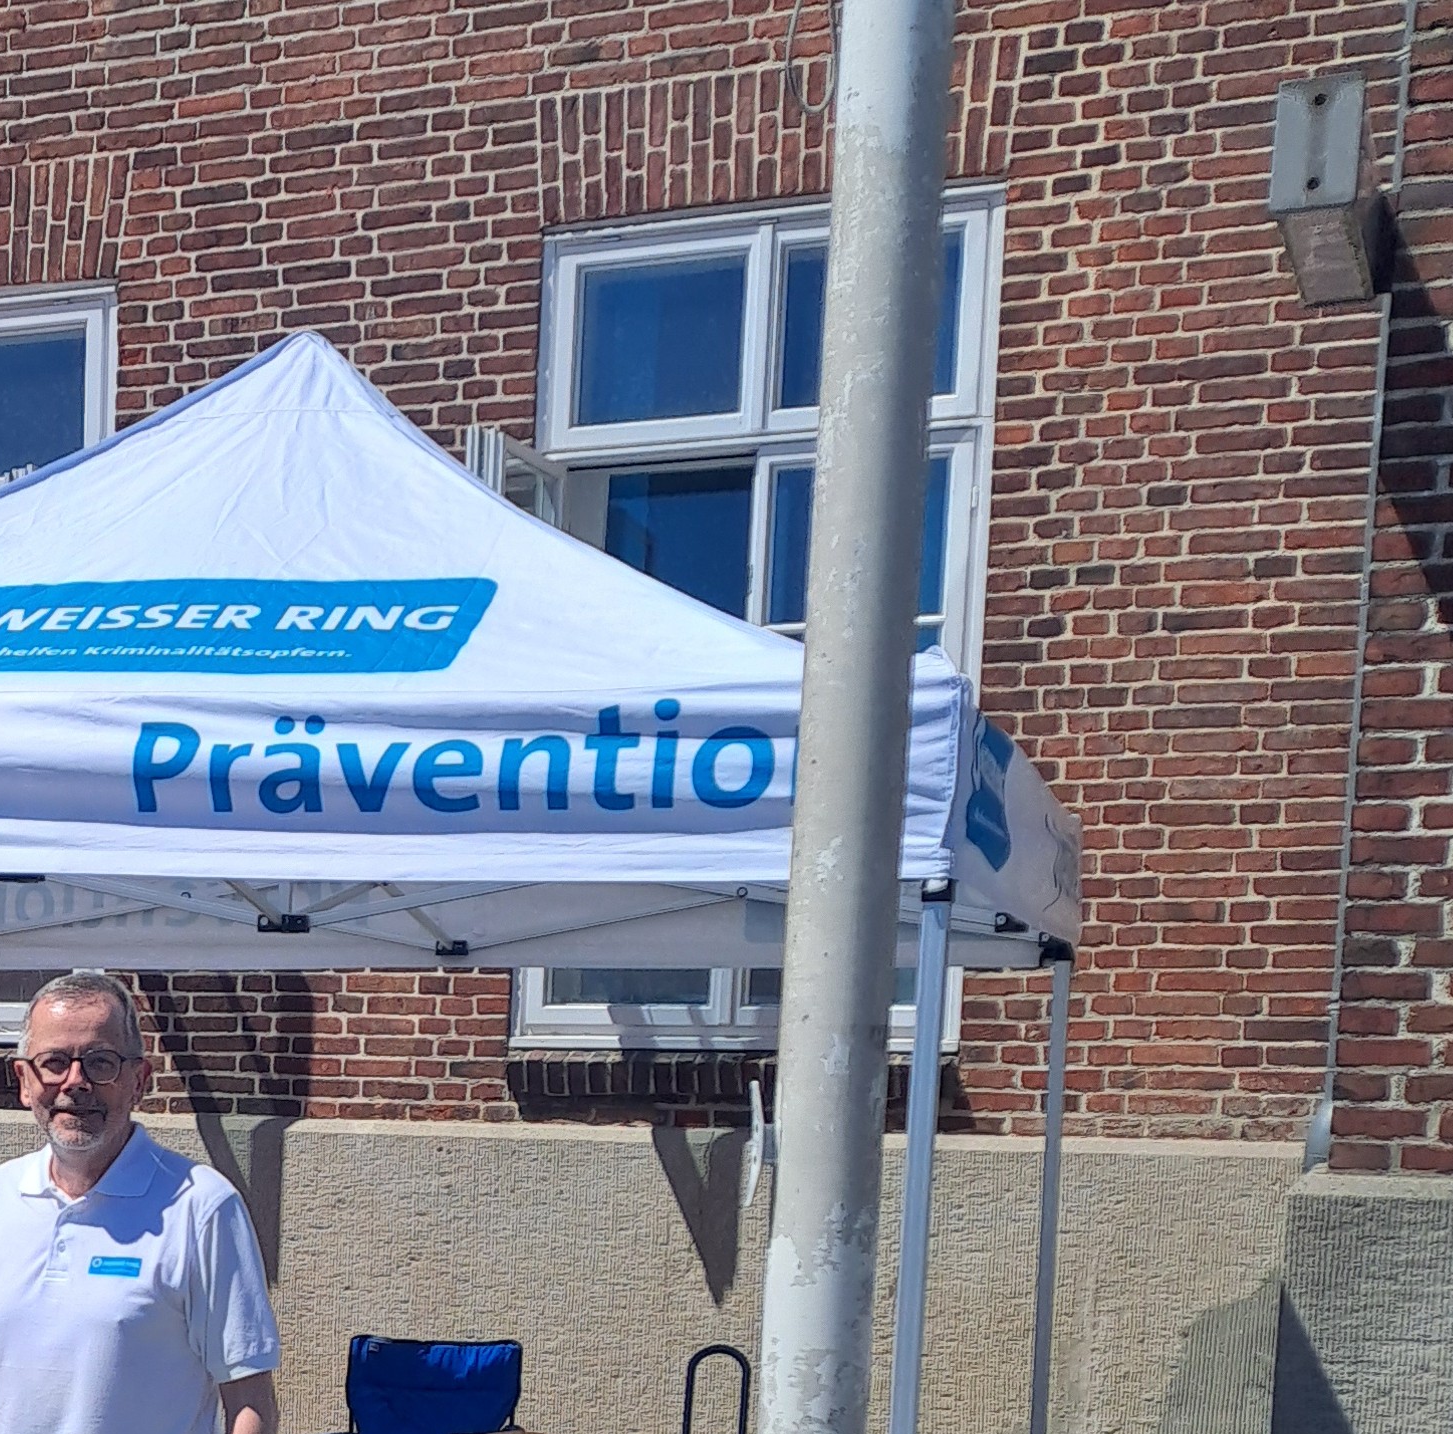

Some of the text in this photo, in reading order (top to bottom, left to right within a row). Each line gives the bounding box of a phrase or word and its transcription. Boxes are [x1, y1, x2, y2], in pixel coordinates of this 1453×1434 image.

[276, 604, 461, 633] RING
[85, 645, 353, 661] Kriminalitätsopfern.
[131, 698, 798, 814] Präventio
